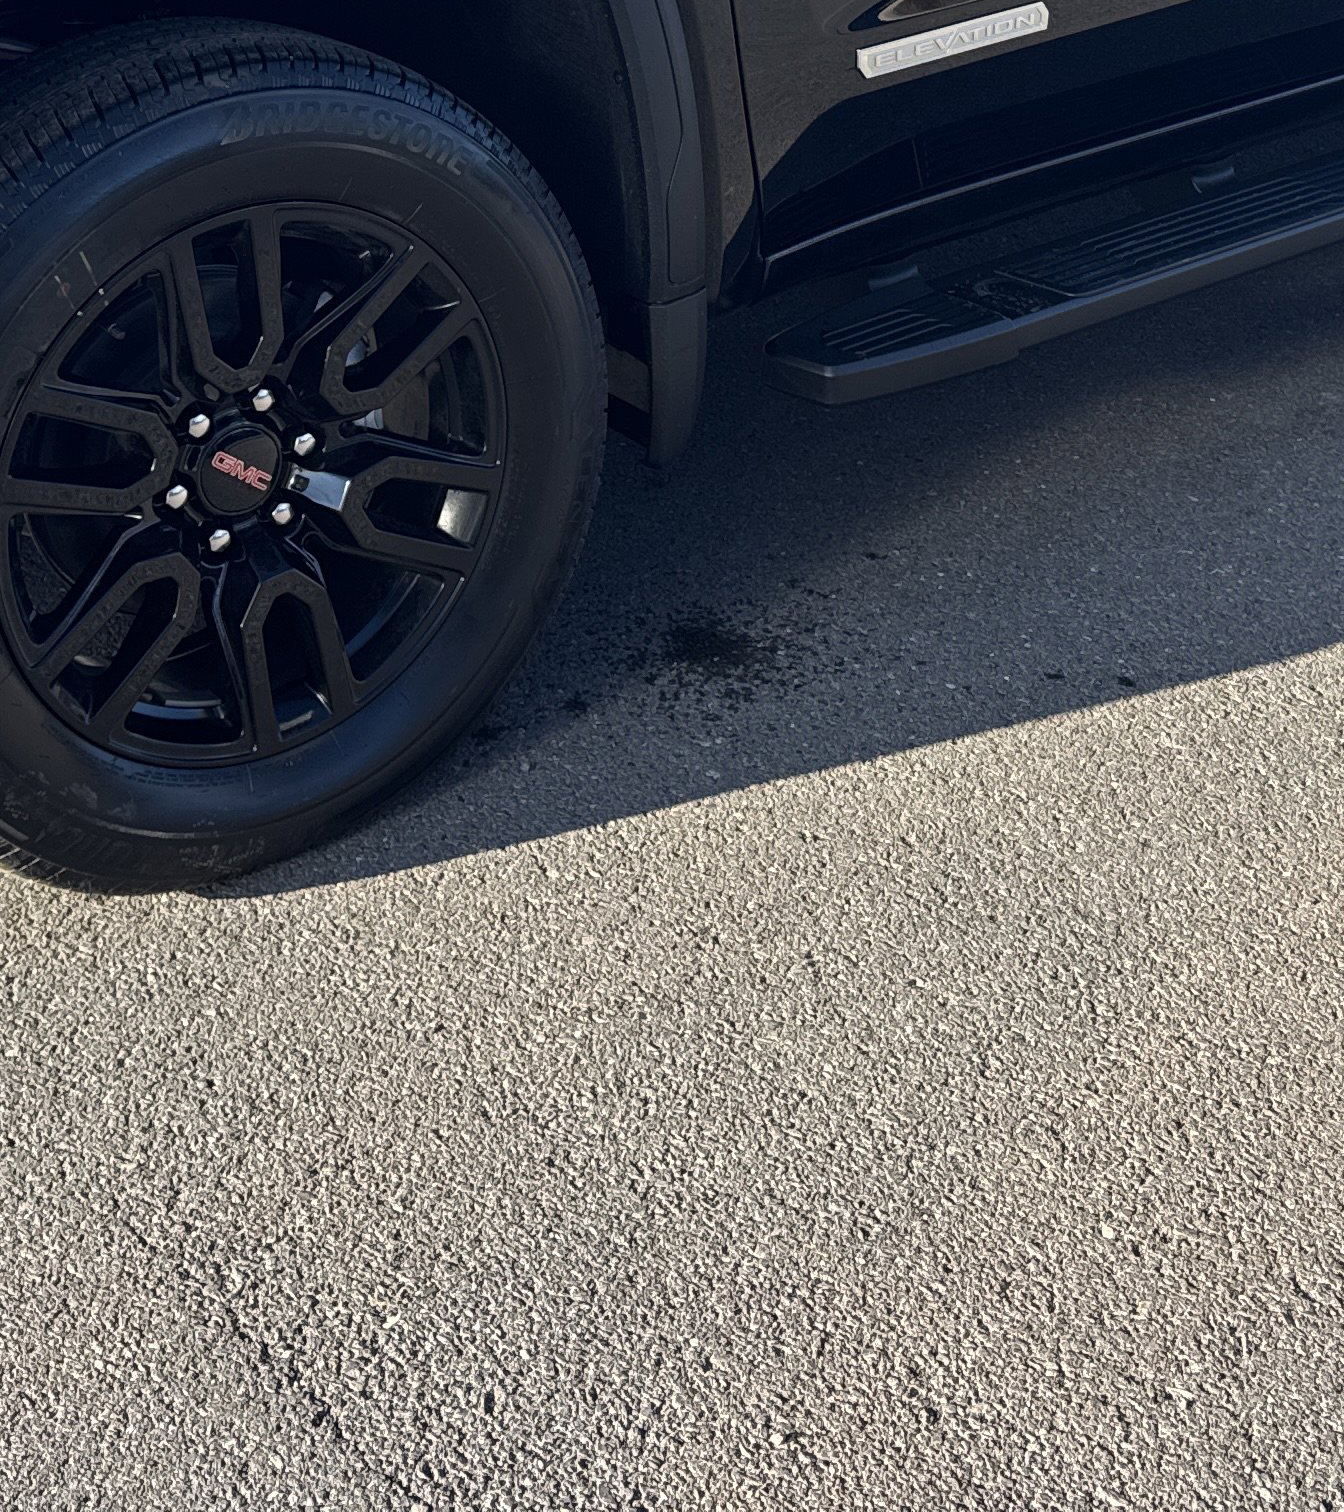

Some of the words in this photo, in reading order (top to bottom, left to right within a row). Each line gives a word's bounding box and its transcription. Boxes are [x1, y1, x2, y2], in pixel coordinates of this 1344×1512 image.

[874, 13, 1035, 67] ELEVATION
[220, 99, 475, 176] BRIDGESTONE
[212, 451, 273, 491] GMC
